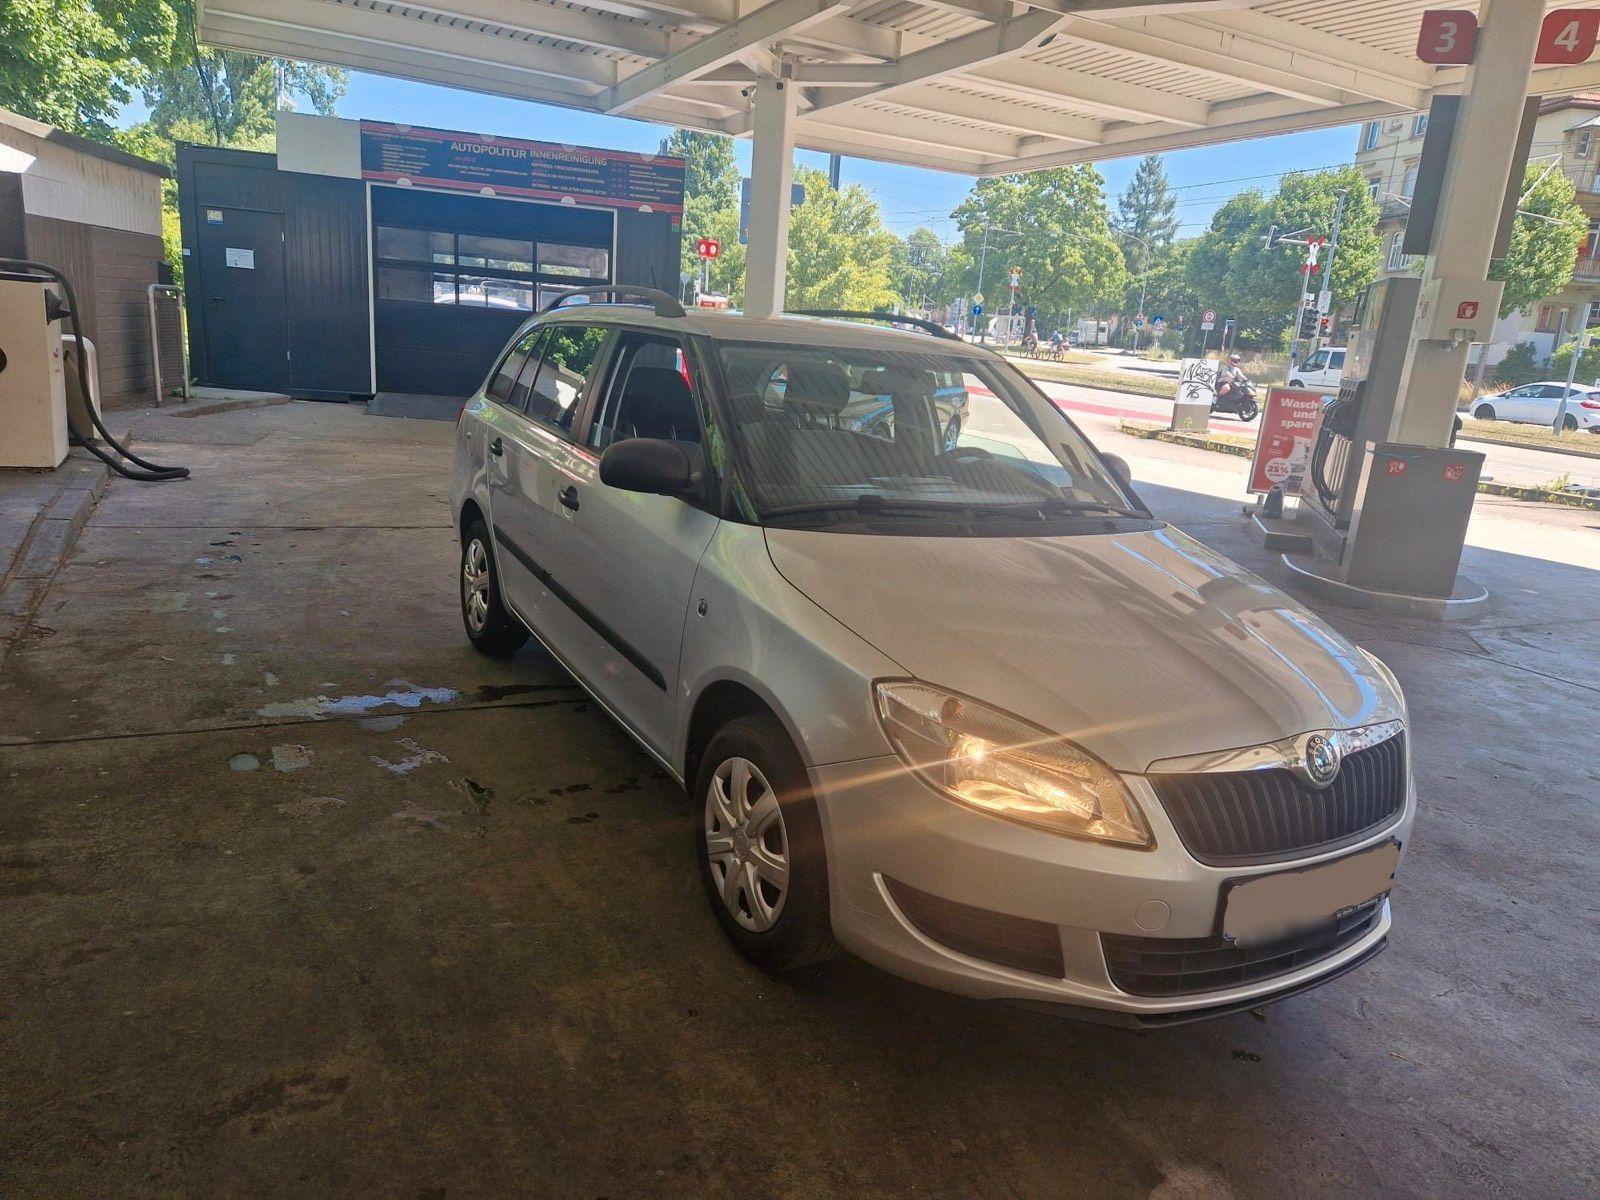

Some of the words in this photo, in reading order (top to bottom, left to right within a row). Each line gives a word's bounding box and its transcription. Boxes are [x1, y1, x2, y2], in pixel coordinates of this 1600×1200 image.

[1434, 20, 1458, 53] 3
[1553, 20, 1580, 53] 4
[450, 141, 527, 159] AUTOPOLITUR
[529, 149, 608, 166] INNENREINIGUNG
[1281, 397, 1319, 409] Wasch
[1292, 410, 1317, 419] und
[1280, 419, 1314, 429] spare
